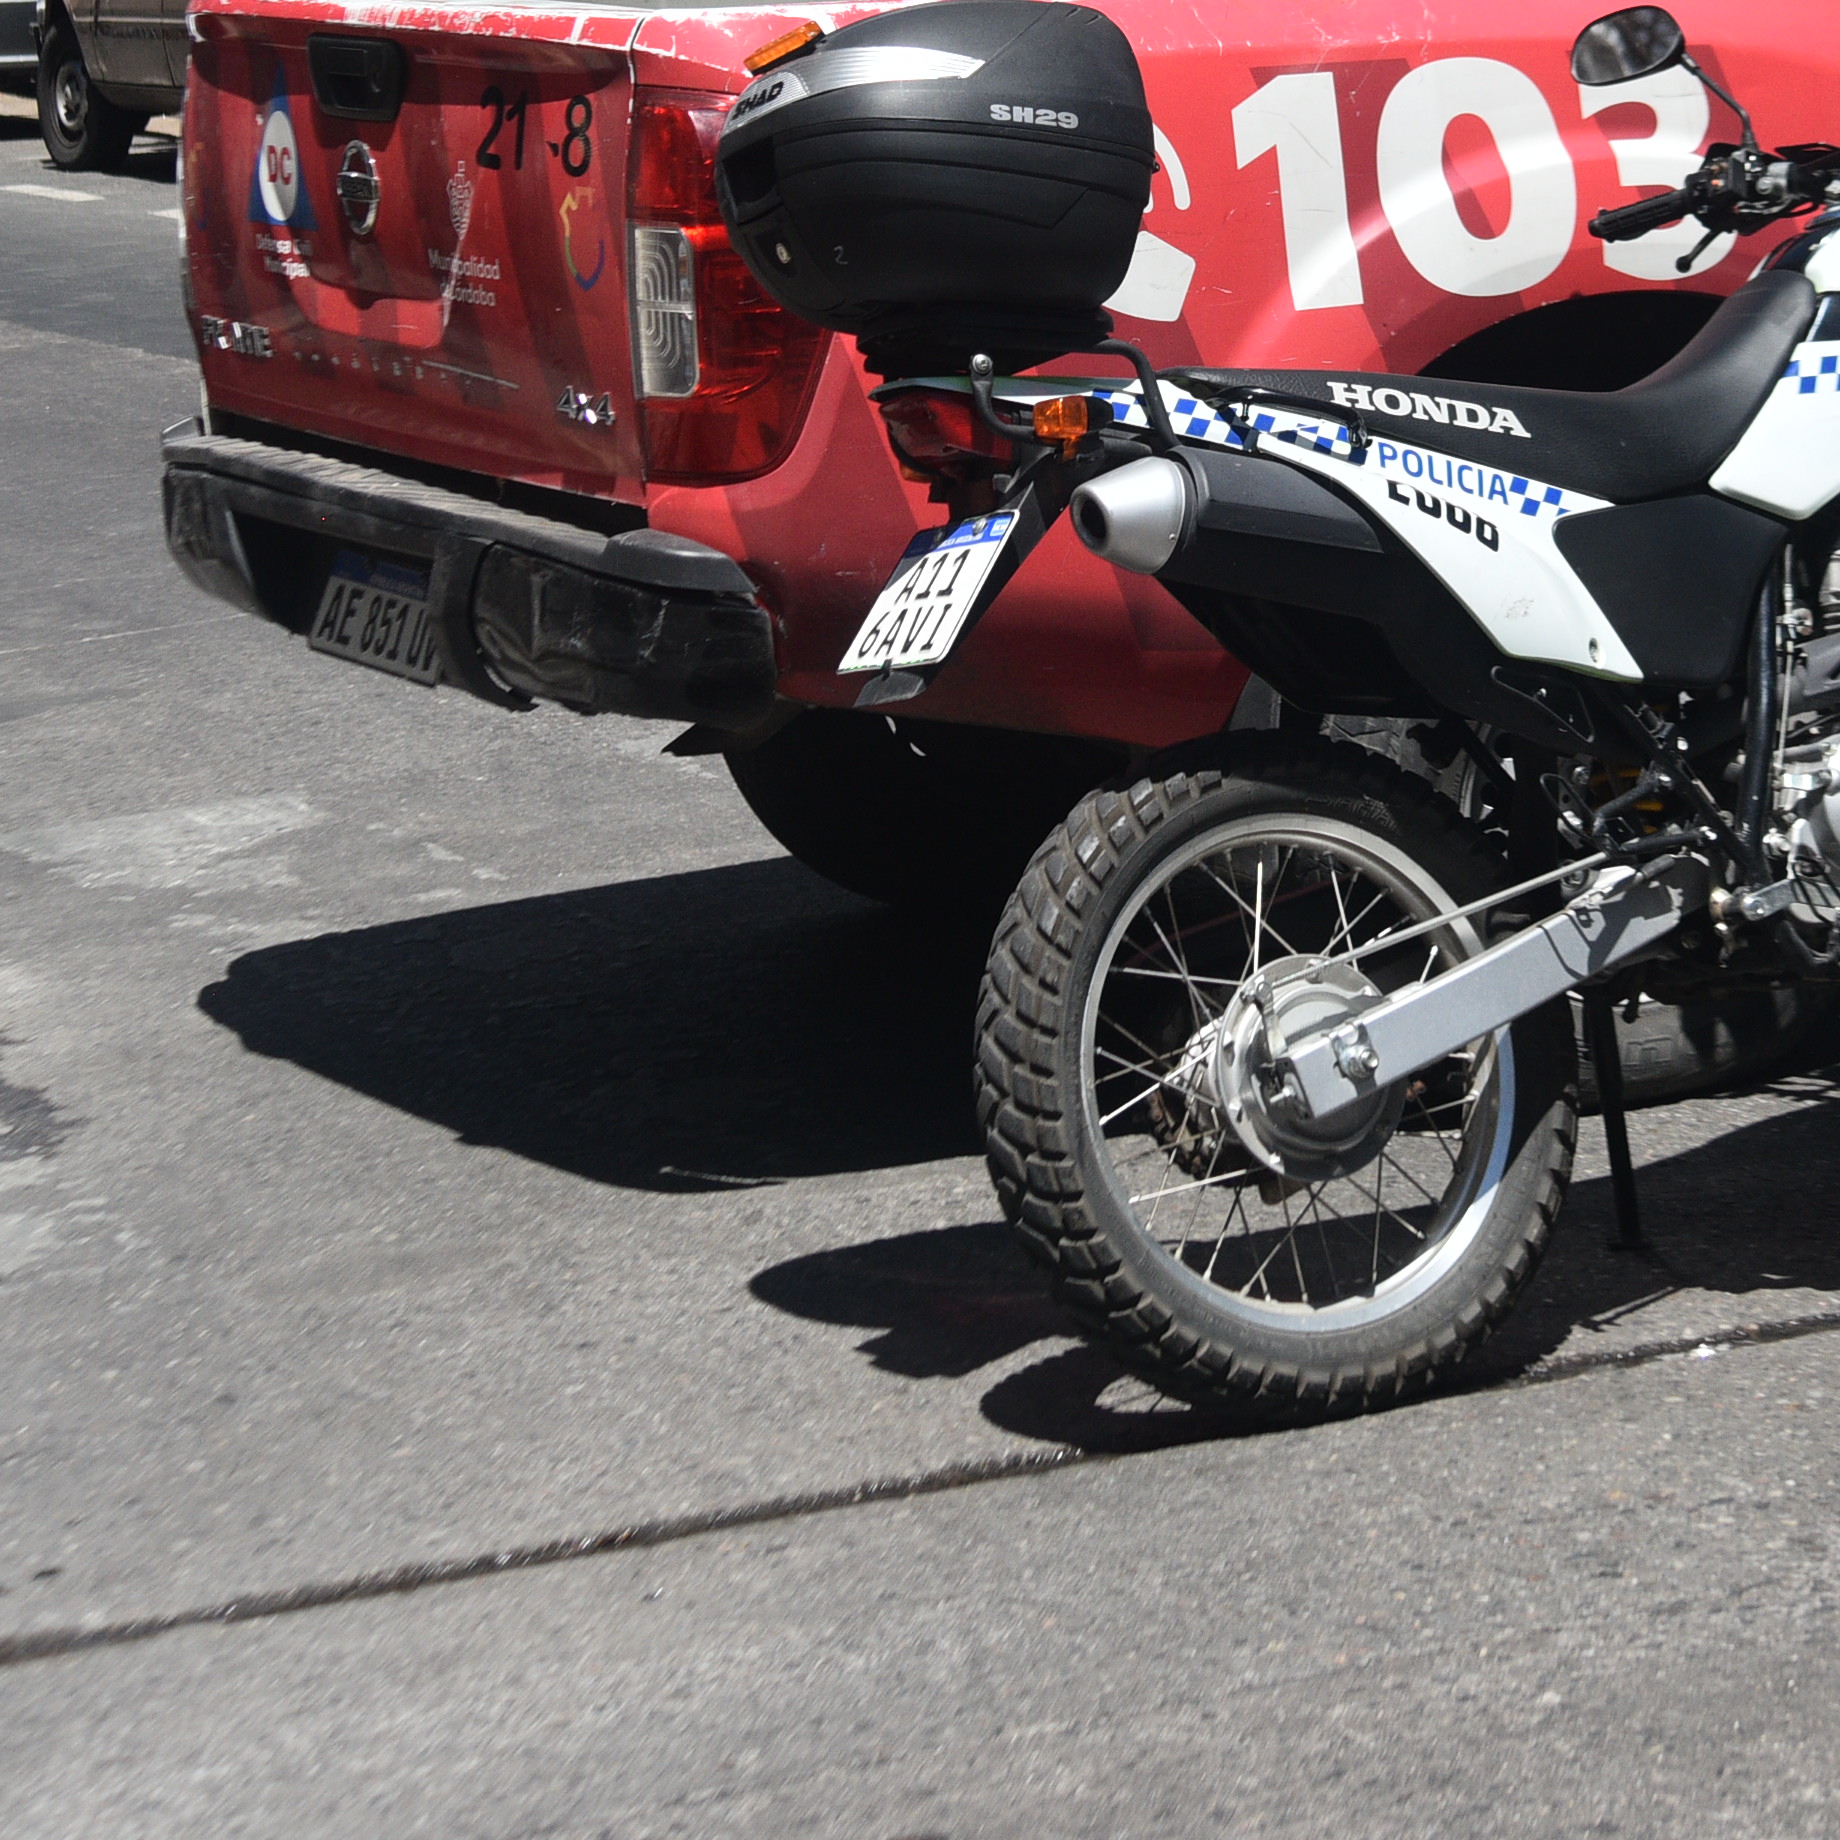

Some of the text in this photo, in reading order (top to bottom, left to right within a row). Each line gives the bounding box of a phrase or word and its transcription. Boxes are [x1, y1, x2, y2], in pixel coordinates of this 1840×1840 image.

[731, 80, 785, 120] SHAD
[989, 103, 1080, 130] SH29
[266, 144, 292, 186] DC
[1230, 56, 1739, 312] 103
[556, 383, 617, 426] 4x4
[1326, 381, 1532, 439] HONDA
[1377, 441, 1510, 506] POLICIA
[893, 548, 972, 606] A11
[316, 584, 366, 646] AE
[360, 594, 411, 662] 851
